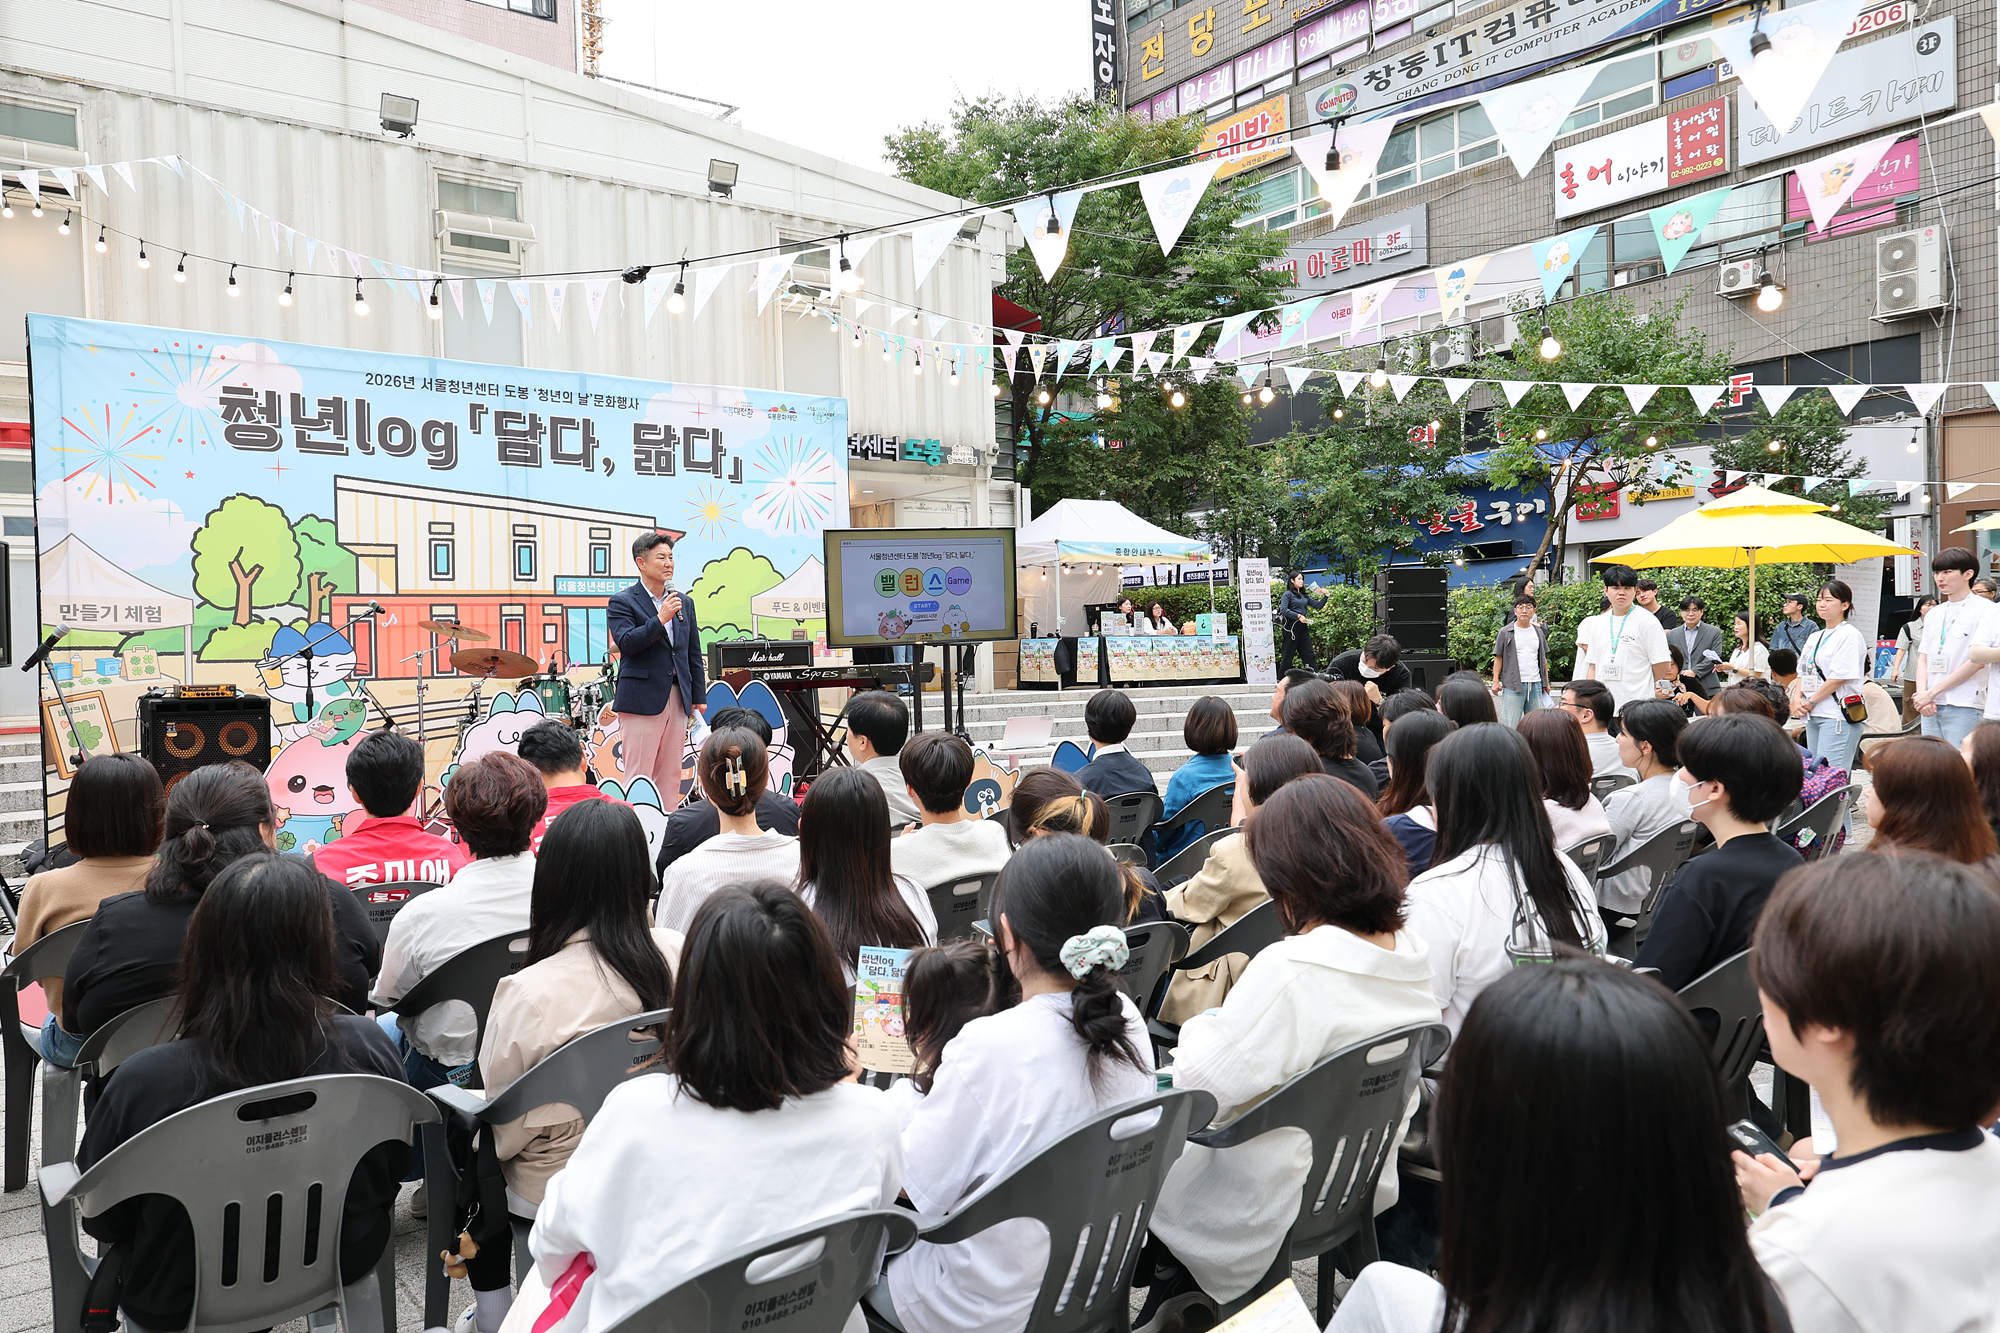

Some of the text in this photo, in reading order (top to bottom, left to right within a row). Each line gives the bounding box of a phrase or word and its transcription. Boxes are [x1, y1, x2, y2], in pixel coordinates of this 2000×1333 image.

[1917, 33, 1939, 53] 3F
[1396, 78, 1439, 101] CHANG
[1443, 62, 1480, 83] DONG
[1484, 54, 1499, 67] IT
[1504, 21, 1581, 60] COMPUTER
[1319, 90, 1355, 111] COMPUTER
[1617, 156, 1665, 183] 이야기
[1670, 160, 1713, 179] 02-992-0223
[1386, 231, 1401, 247] 3F
[1306, 237, 1374, 278] 아로마
[365, 372, 415, 390] 2026년
[420, 376, 500, 399] 서울청년센터
[504, 384, 530, 400] 도봉
[219, 384, 459, 470] 청년log
[902, 438, 945, 467] 도봉
[557, 579, 616, 593] 서울청년센터
[947, 576, 970, 586] Game
[59, 603, 163, 624] 만들기 체험
[771, 600, 791, 614] 푸드
[913, 602, 932, 610] START
[769, 671, 793, 681] YAMAHA
[345, 858, 451, 886] 조미애
[861, 953, 895, 967] 청년log
[245, 1135, 308, 1154] 010-8488-2424
